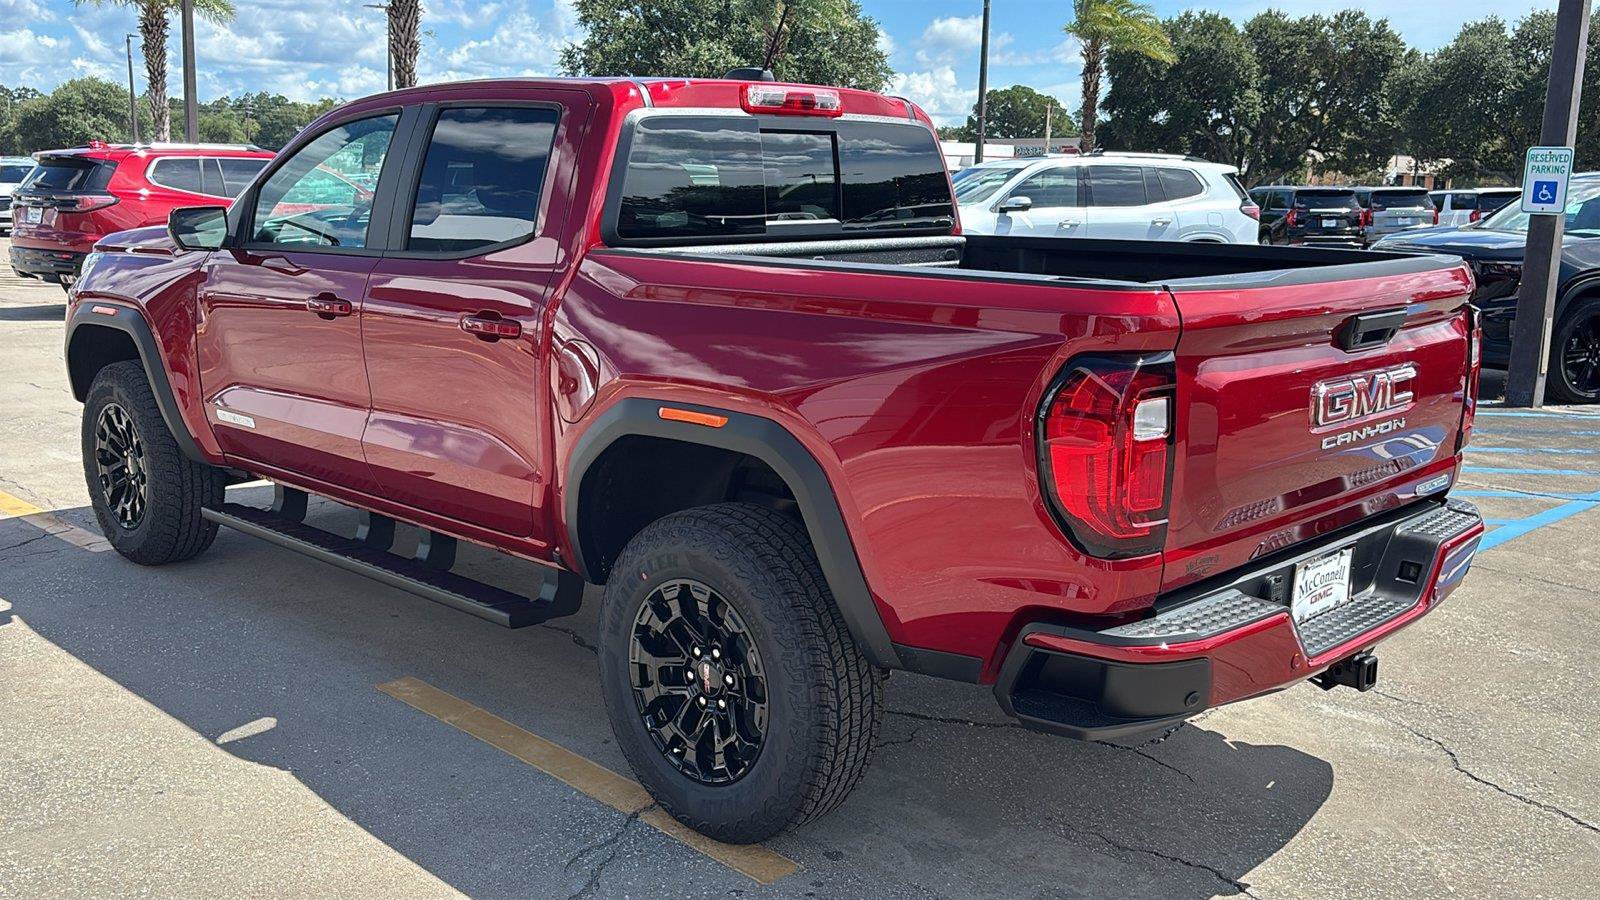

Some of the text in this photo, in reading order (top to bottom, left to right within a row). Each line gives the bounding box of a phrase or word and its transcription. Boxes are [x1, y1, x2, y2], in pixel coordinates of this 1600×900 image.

[1530, 153, 1569, 163] RESERVED
[1531, 165, 1566, 174] PARKING
[1317, 364, 1417, 427] GMC
[1322, 417, 1405, 450] CANYON
[1298, 565, 1346, 600] McConnell
[1310, 586, 1333, 604] GMC
